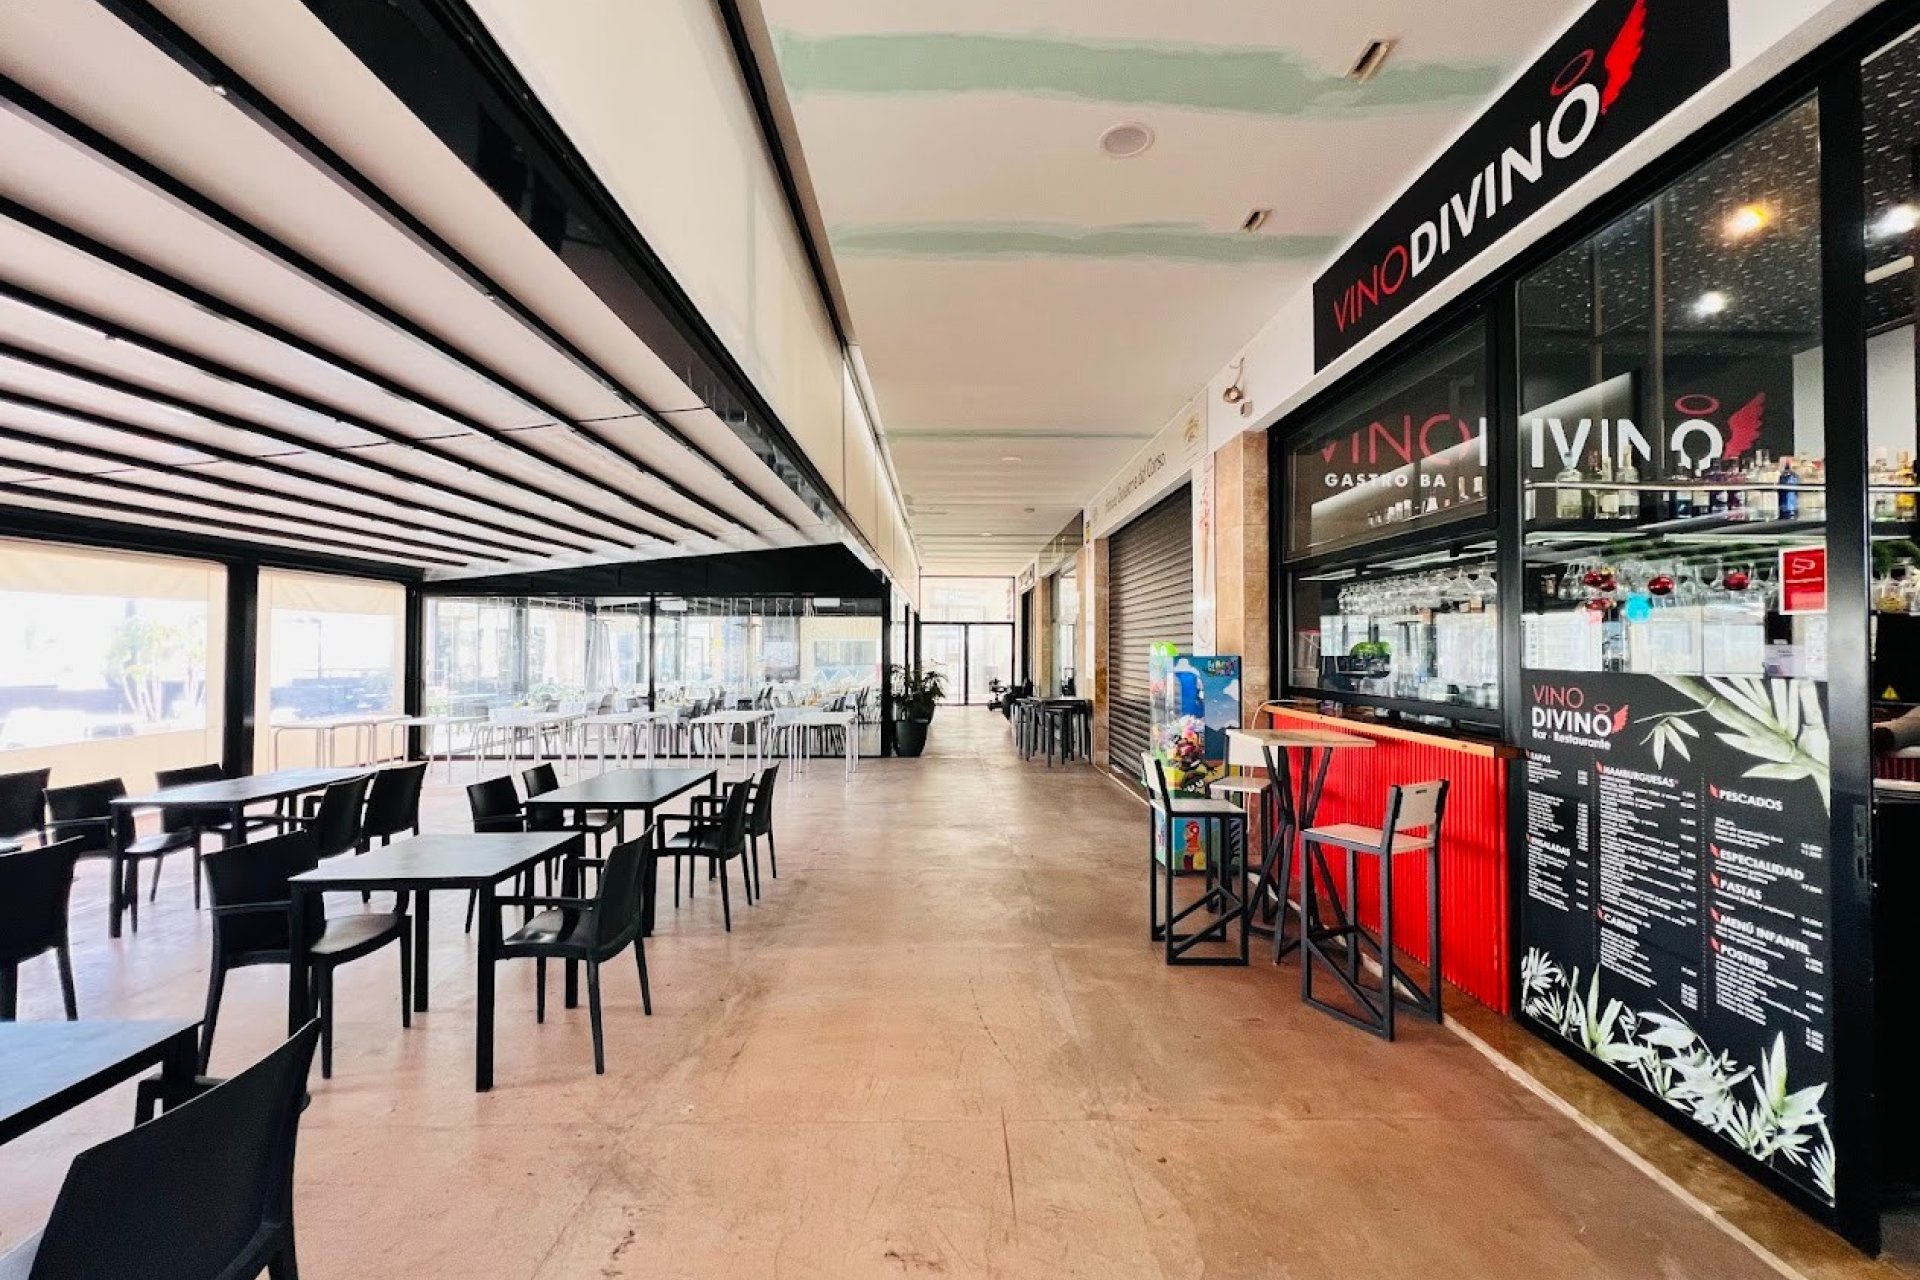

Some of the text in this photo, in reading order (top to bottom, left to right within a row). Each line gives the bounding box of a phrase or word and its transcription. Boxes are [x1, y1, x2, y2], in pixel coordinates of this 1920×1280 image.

[1324, 473, 1408, 488] GASTRO
[1532, 684, 1584, 709] VINO
[1532, 706, 1612, 737] DIVINO
[1532, 728, 1612, 751] Bar Restaurante
[1720, 789, 1783, 811] PESCADOS
[1720, 849, 1805, 880] ESPECIALIDAD
[1720, 879, 1762, 900] PASTAS
[1720, 914, 1754, 935] MENÚ
[1756, 927, 1811, 956] INFANTIL
[1720, 944, 1769, 971] POSTRES
